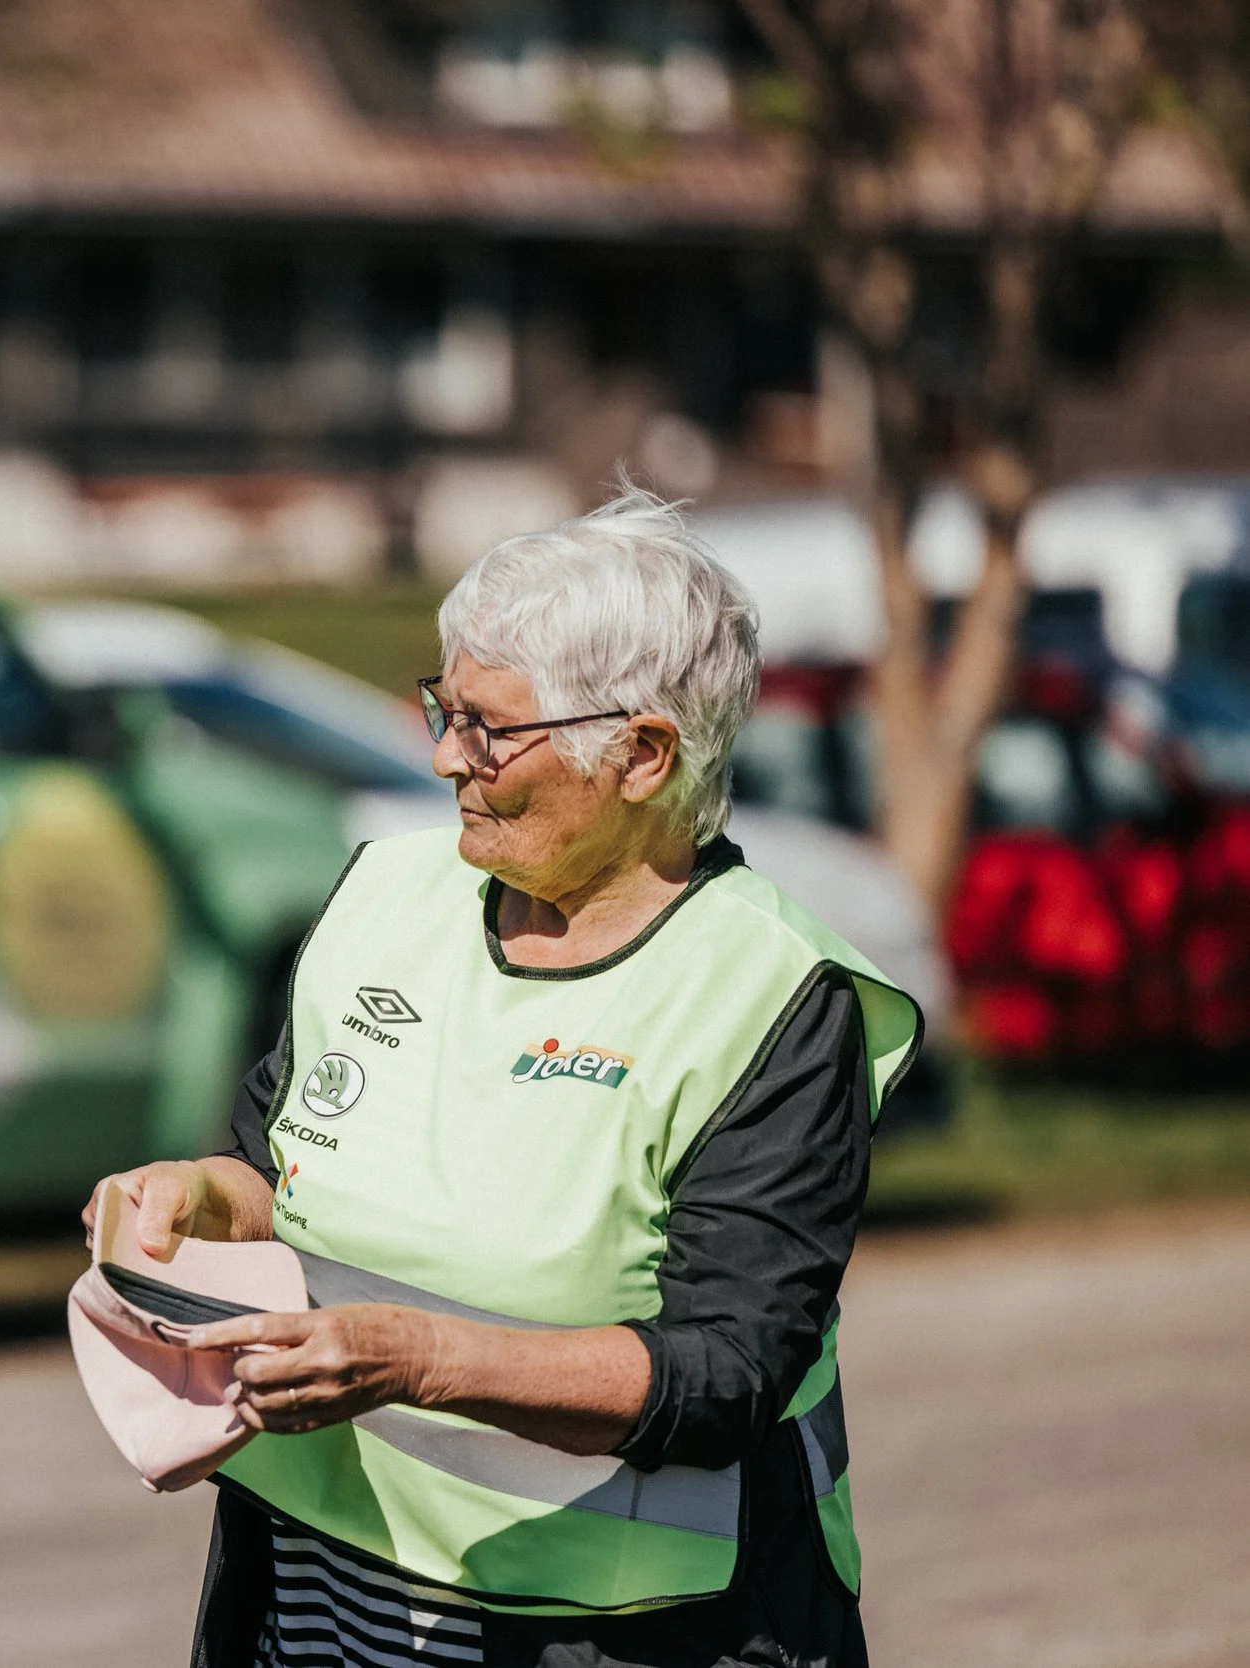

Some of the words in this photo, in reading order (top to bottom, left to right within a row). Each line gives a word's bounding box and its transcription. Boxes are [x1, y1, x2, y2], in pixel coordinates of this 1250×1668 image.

[342, 1013, 400, 1049] umbro
[276, 1116, 338, 1151] ŠKODA
[281, 1204, 307, 1229] Tipping
